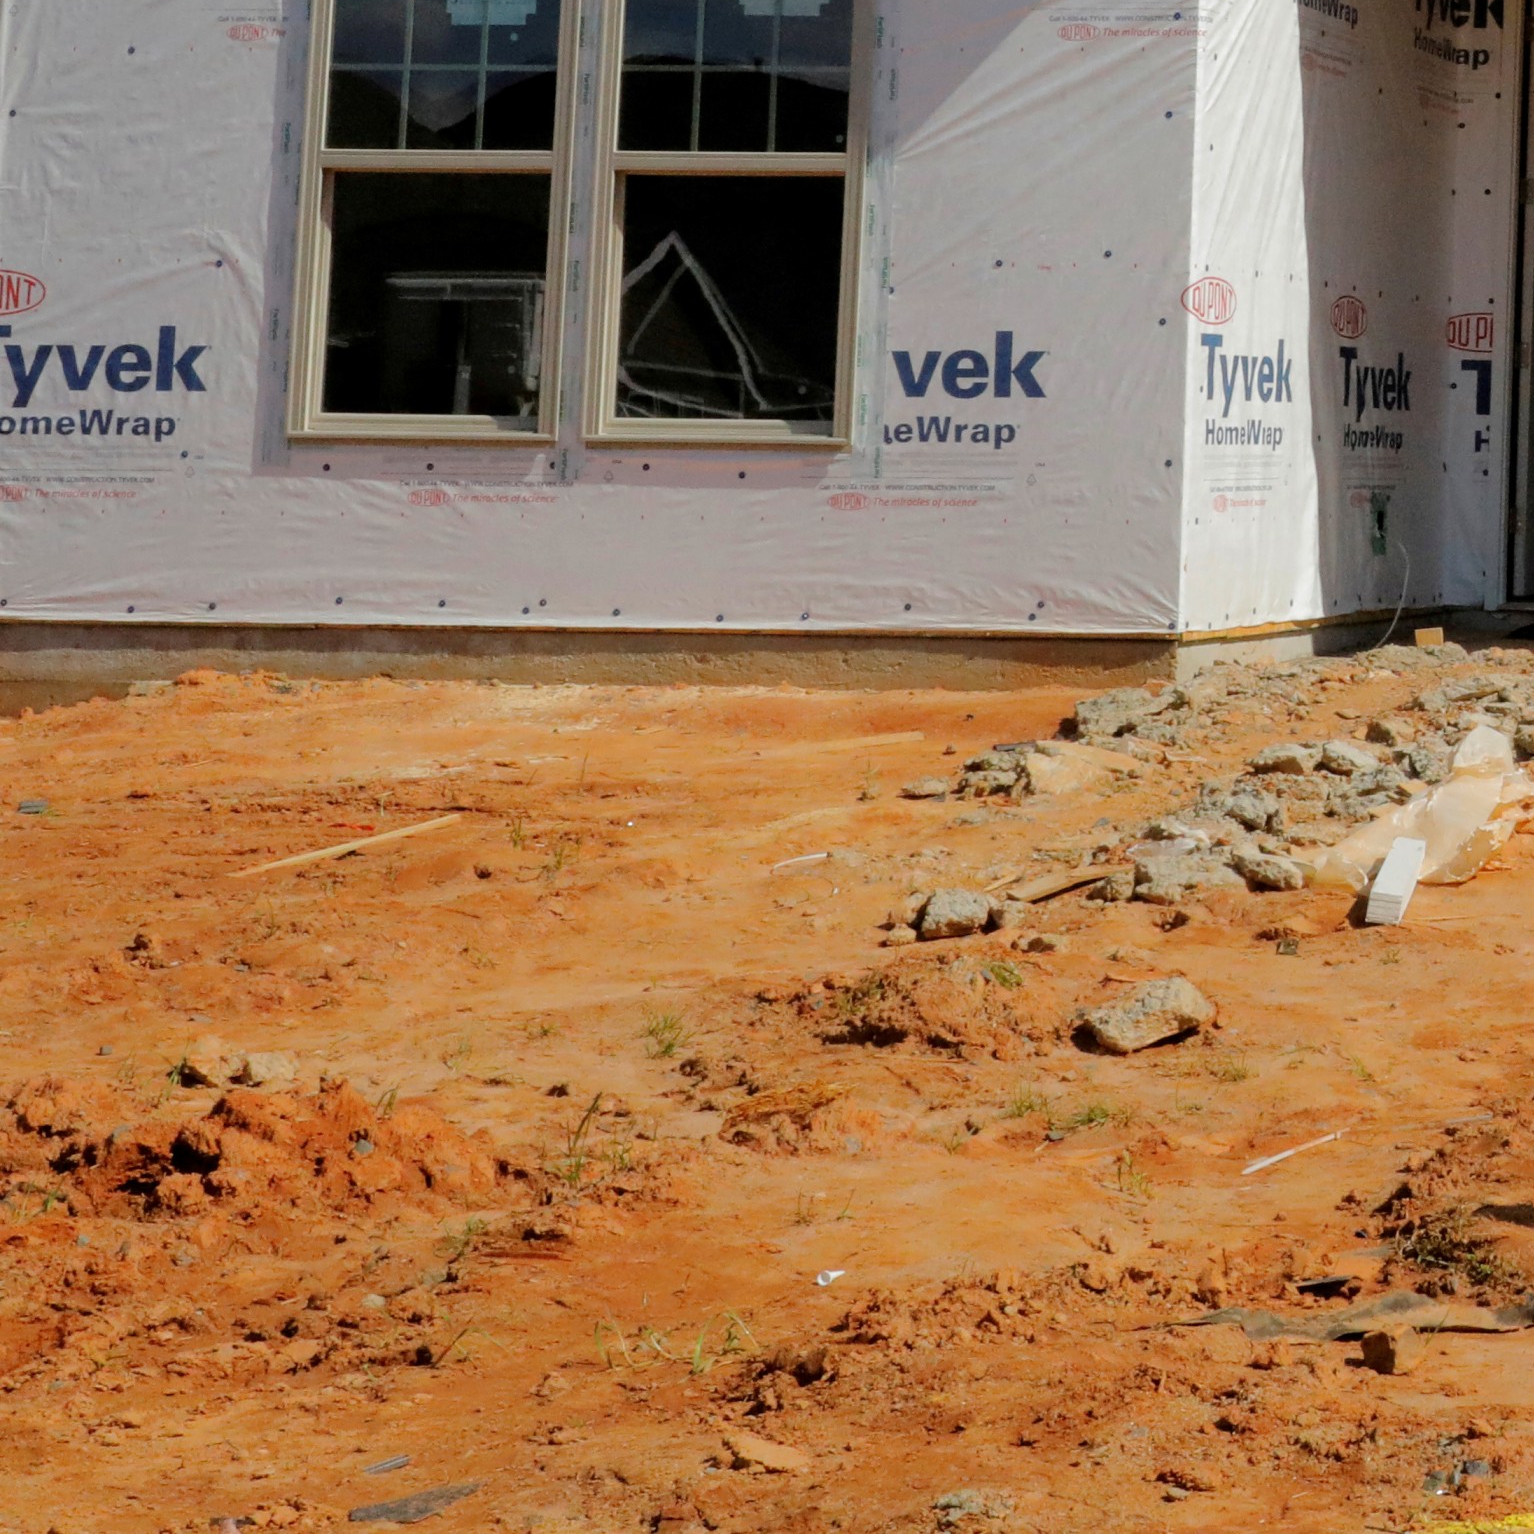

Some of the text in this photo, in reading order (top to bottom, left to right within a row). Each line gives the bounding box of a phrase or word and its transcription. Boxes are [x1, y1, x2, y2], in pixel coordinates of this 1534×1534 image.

[1414, 26, 1489, 70] HomeWrap
[1200, 333, 1292, 417] Tyvek
[1339, 346, 1411, 419] Tyvek
[0, 408, 178, 442] omeWrap
[1205, 418, 1283, 452] HomeWrap
[1343, 421, 1403, 452] HomeWrap
